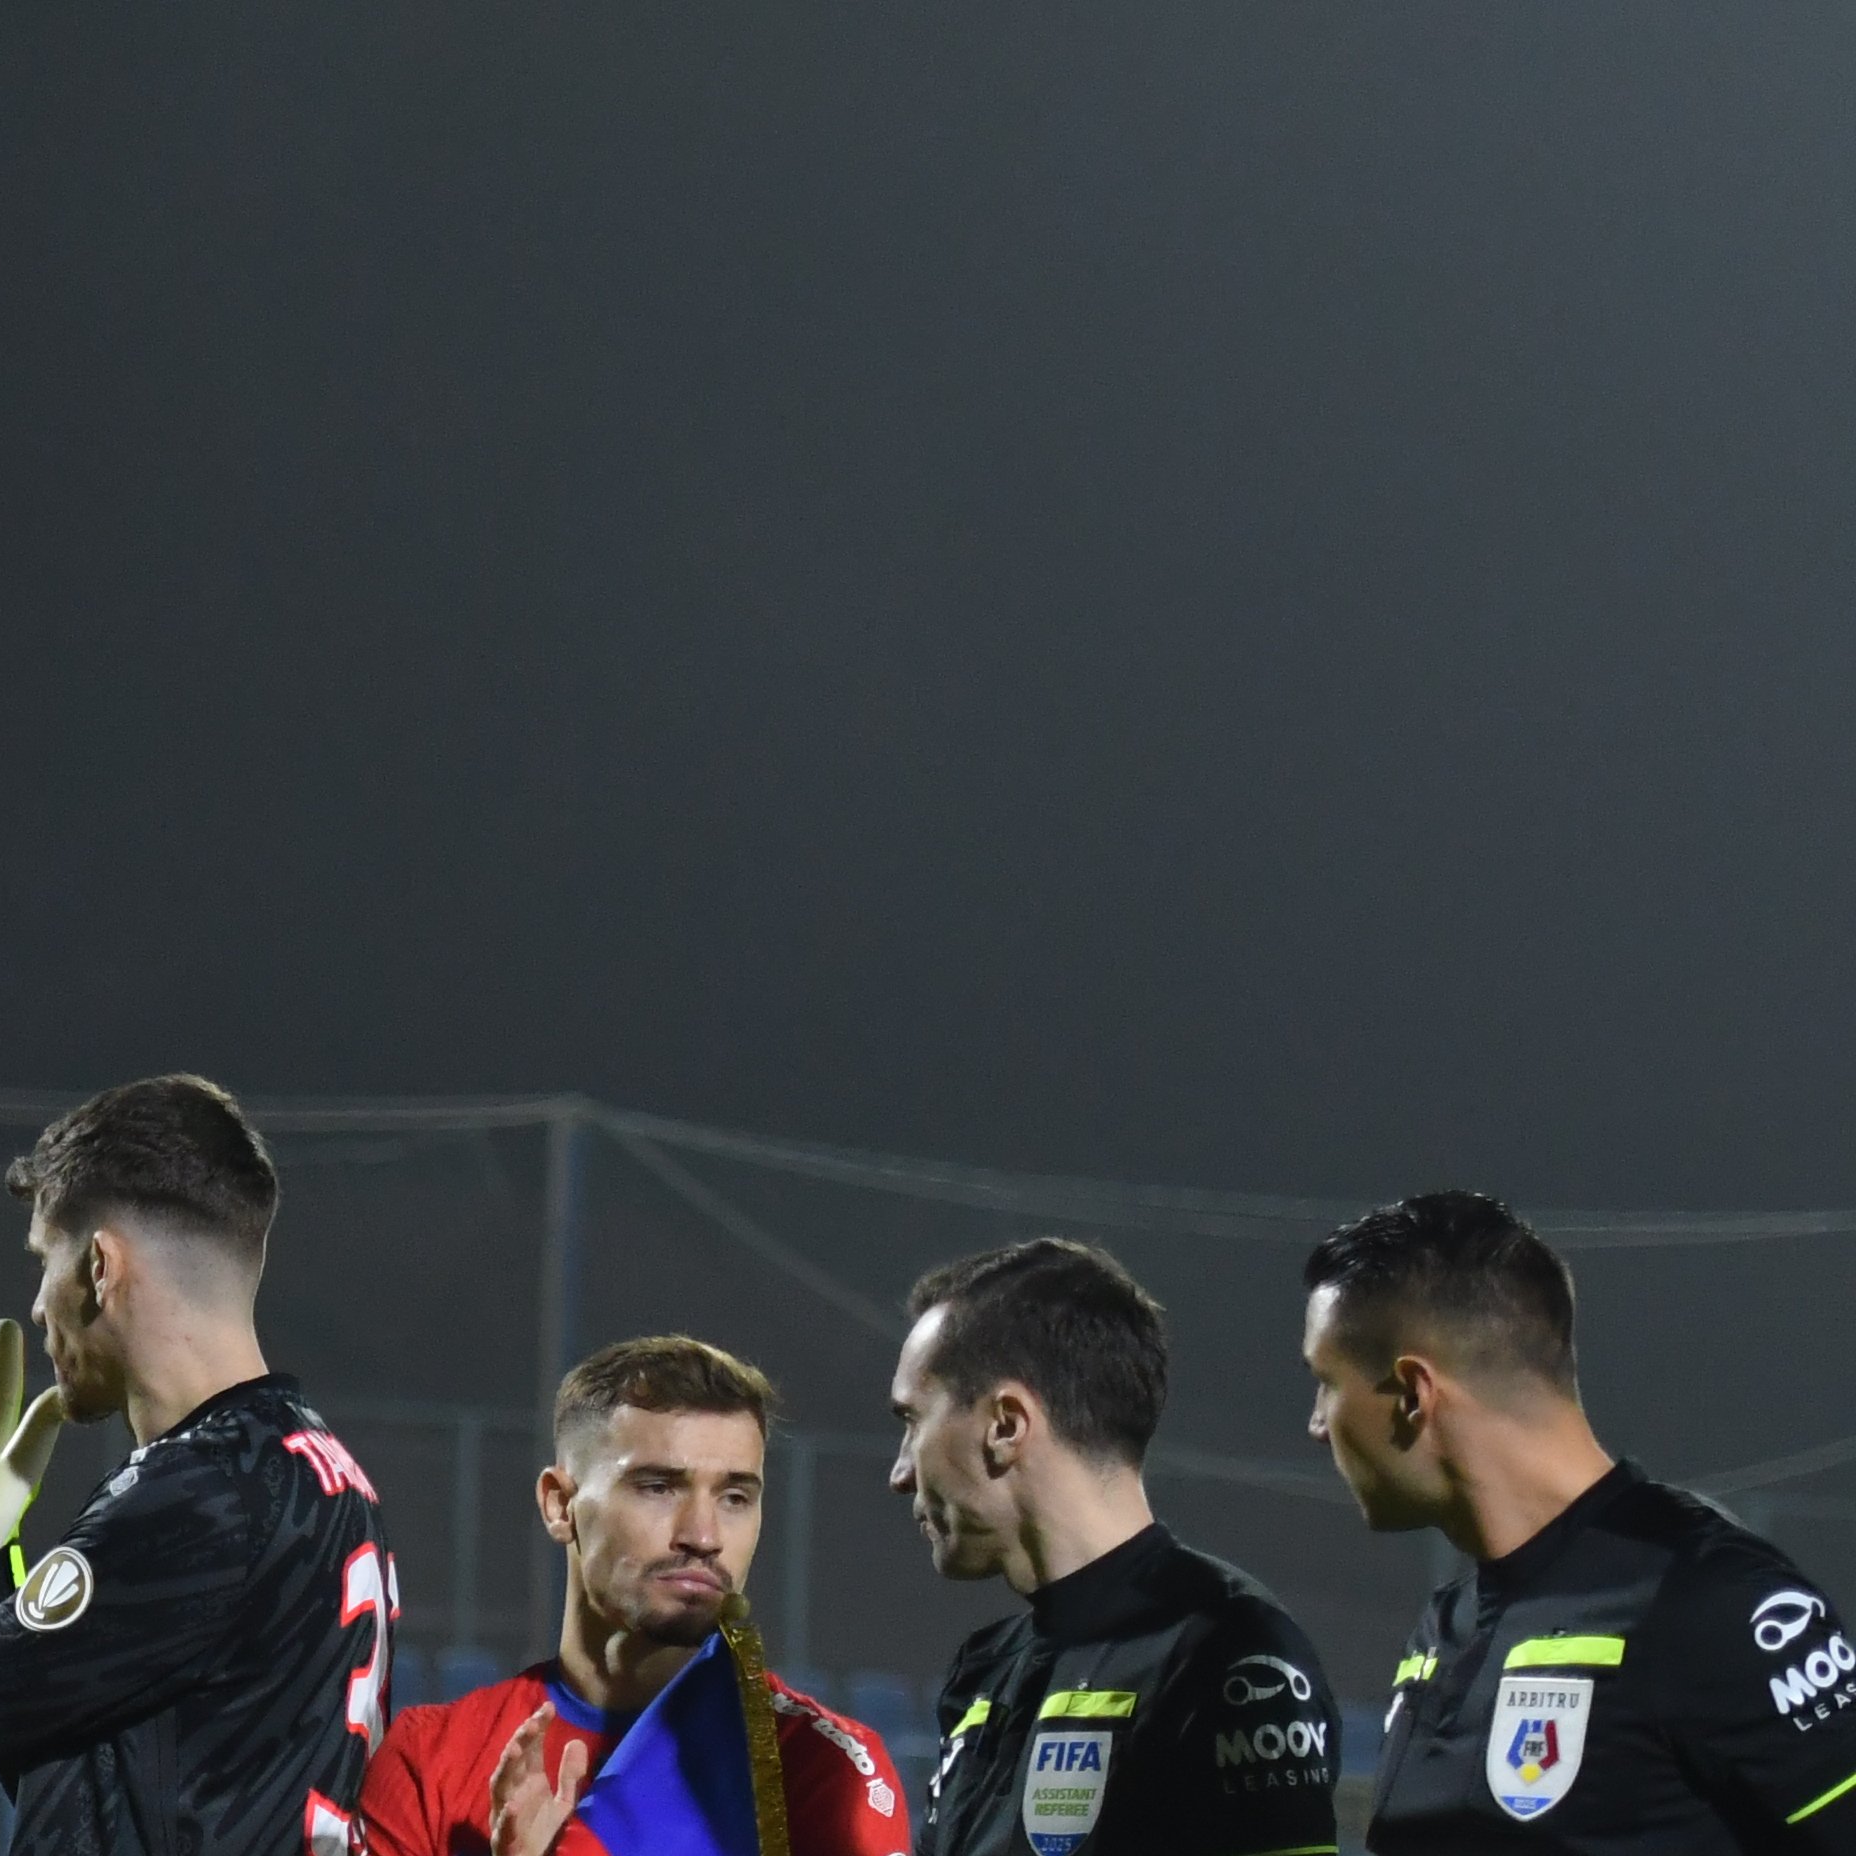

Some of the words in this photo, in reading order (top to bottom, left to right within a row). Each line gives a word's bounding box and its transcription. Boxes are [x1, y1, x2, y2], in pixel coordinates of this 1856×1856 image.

[1768, 1634, 1856, 1715] MOO
[1505, 1690, 1582, 1710] ARBITRU
[1792, 1682, 1856, 1732] LEAS
[1035, 1741, 1102, 1772] FIFA
[1214, 1720, 1328, 1768] MOOV
[1032, 1788, 1098, 1801] ASSISTANT
[1034, 1802, 1090, 1818] REFEREE
